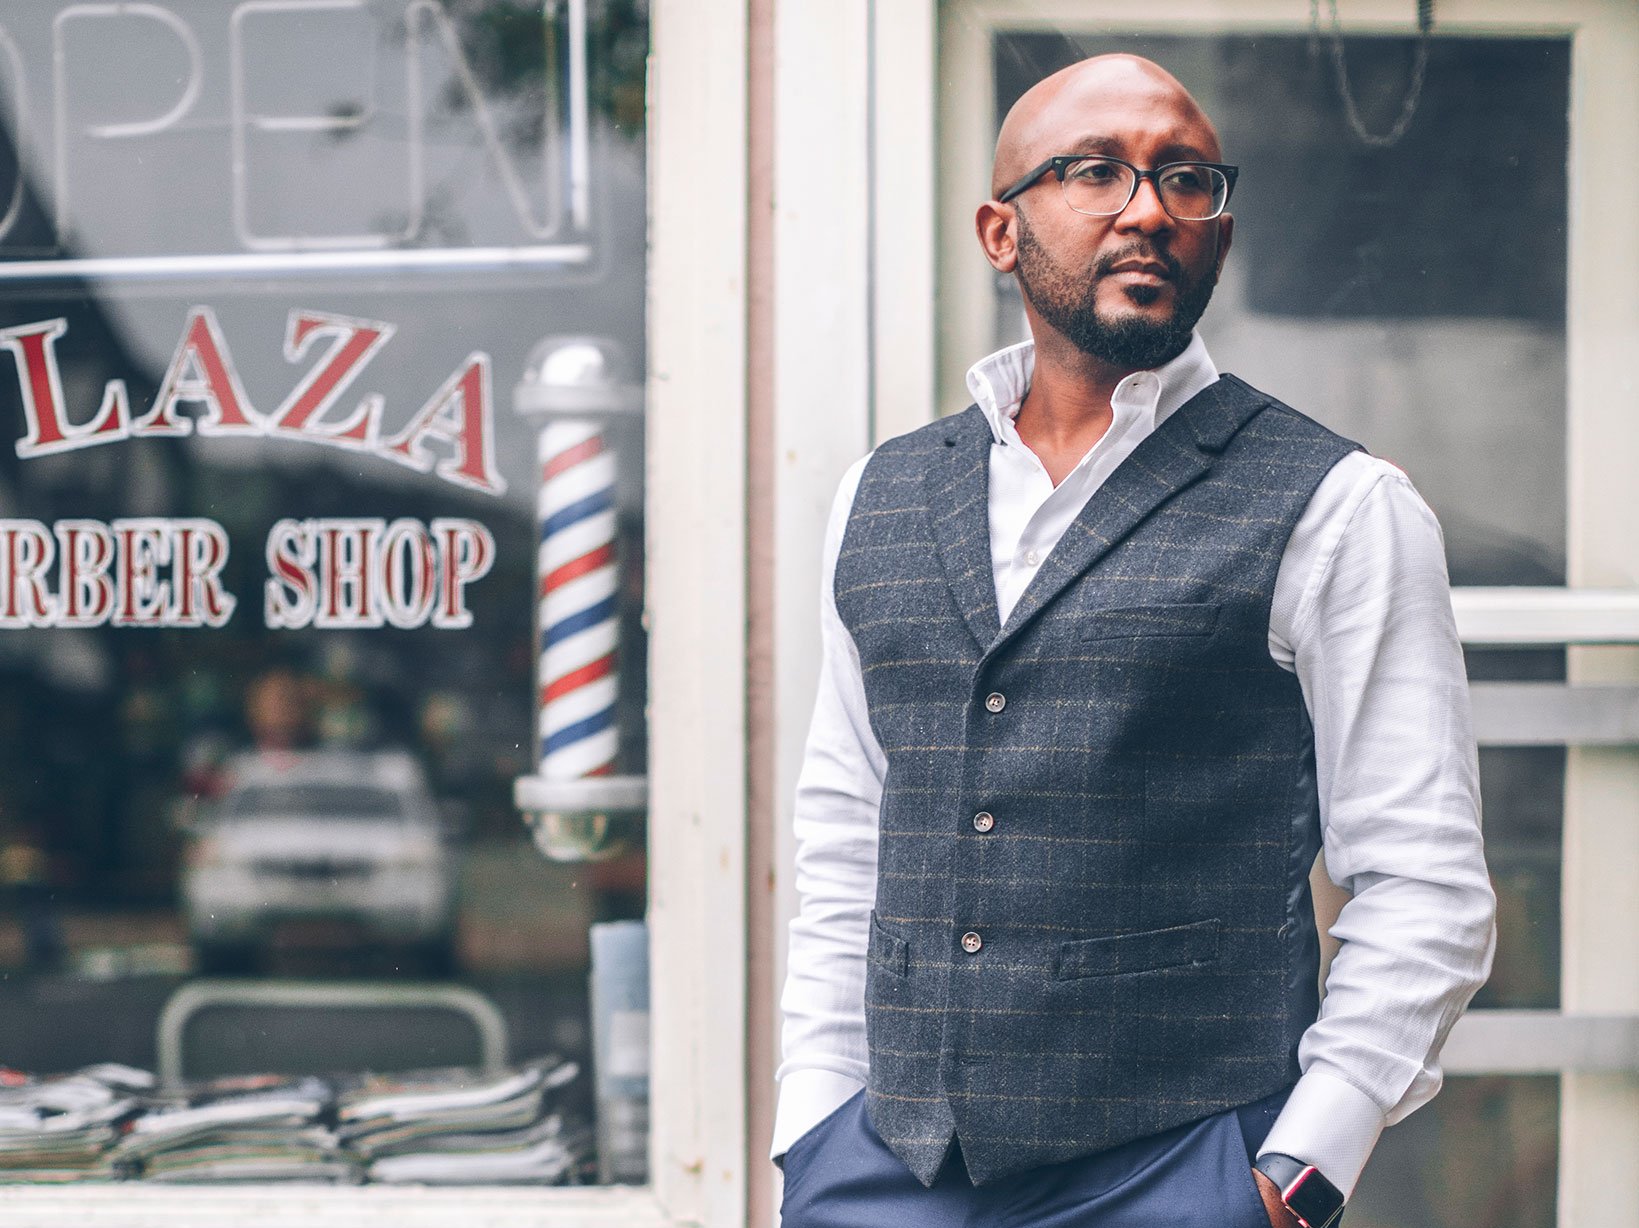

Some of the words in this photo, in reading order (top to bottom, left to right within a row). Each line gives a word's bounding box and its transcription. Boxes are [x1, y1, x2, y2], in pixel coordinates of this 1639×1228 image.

[0, 2, 563, 251] PEN
[0, 304, 507, 497] LAZA
[264, 517, 496, 629] SHOP
